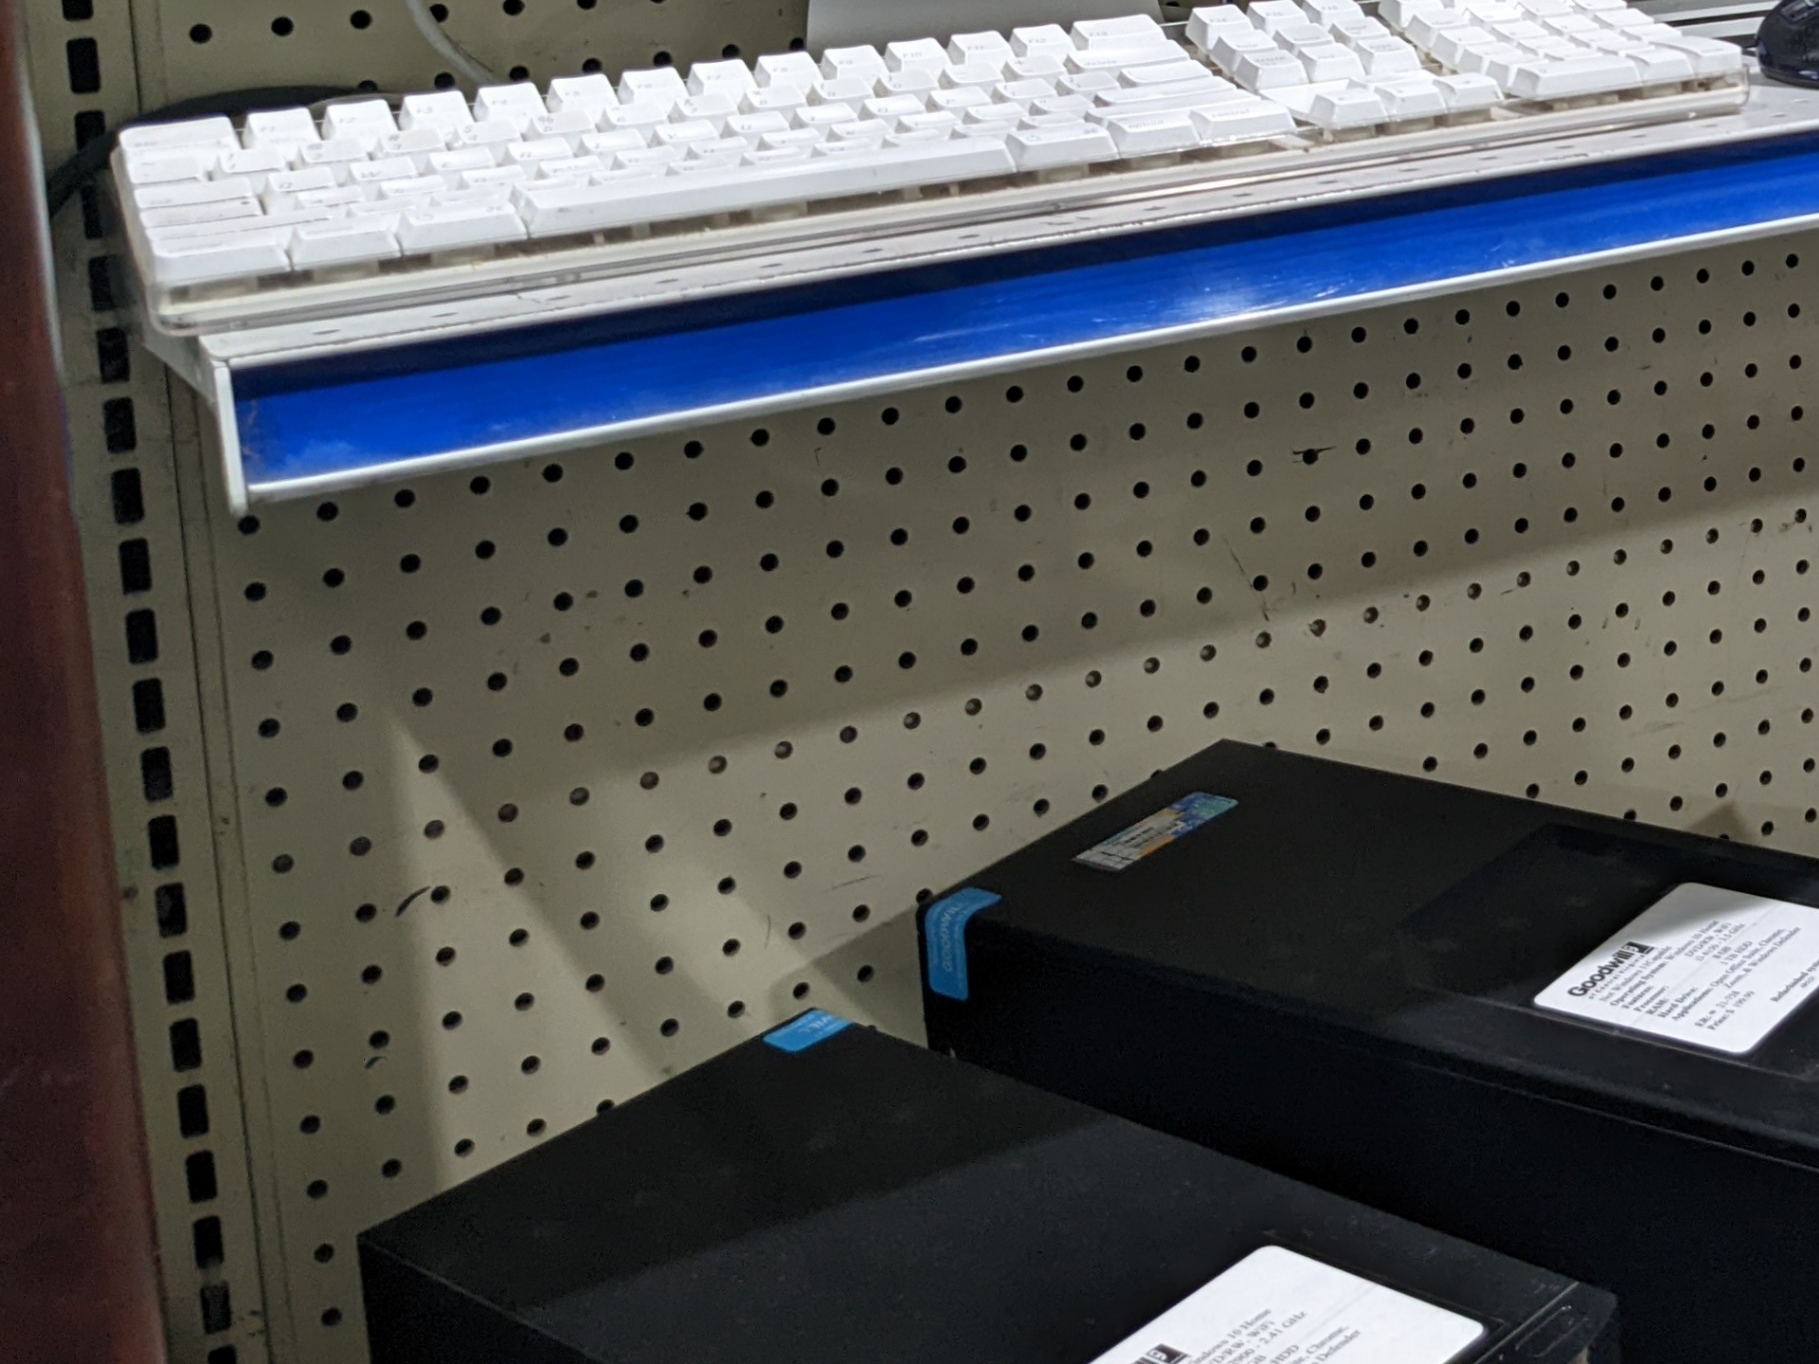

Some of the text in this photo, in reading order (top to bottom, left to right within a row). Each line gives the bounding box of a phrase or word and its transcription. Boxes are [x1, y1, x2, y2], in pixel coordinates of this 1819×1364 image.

[1567, 949, 1635, 997] Goodwill
[1609, 980, 1647, 1006] Operating
[1664, 939, 1695, 961] Windows
[1645, 999, 1668, 1015] RAM:
[1657, 1003, 1679, 1018] Hard
[1239, 1308, 1272, 1330] Home
[1281, 1311, 1307, 1329] GHz
